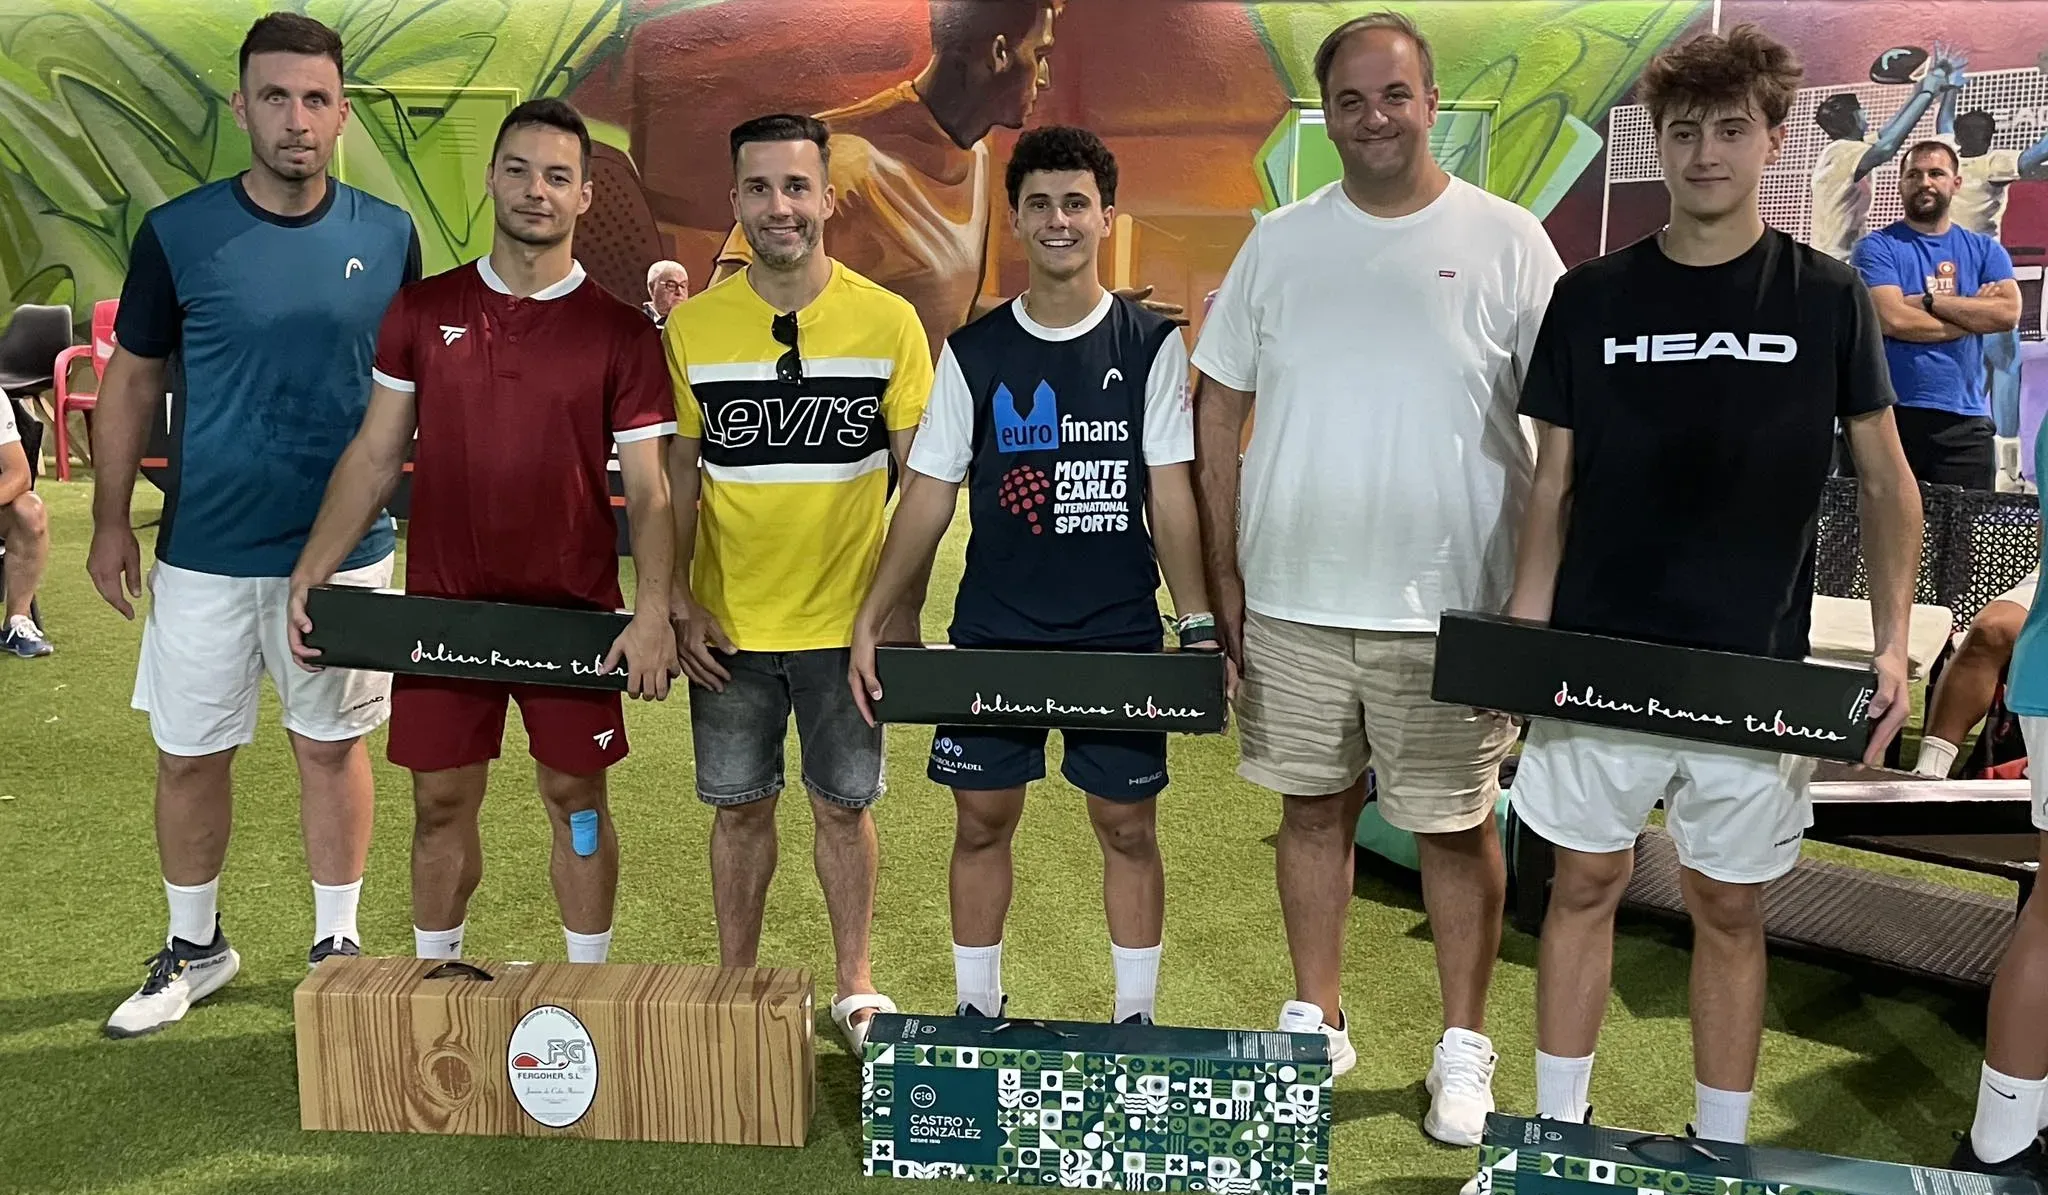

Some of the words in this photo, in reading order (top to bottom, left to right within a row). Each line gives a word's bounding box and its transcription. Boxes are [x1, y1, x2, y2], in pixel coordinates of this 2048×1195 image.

[1603, 331, 1798, 365] HEAD
[1002, 423, 1052, 446] euro
[1061, 414, 1129, 442] finans
[1054, 460, 1129, 481] MONTE
[1055, 480, 1127, 500] CARLO
[1053, 501, 1129, 514] INTERNATIONAL
[1054, 514, 1129, 534] SPORTS
[410, 640, 487, 665] Julian
[491, 650, 562, 670] Ramos
[971, 692, 1043, 715] Julian
[1046, 698, 1115, 715] Ramos
[1122, 695, 1206, 718] tabares
[1554, 681, 1644, 714] Julian
[1647, 698, 1733, 725] Ramos
[1743, 709, 1847, 742] tabares
[910, 1114, 963, 1127] CASTRO
[966, 1117, 976, 1127] Y
